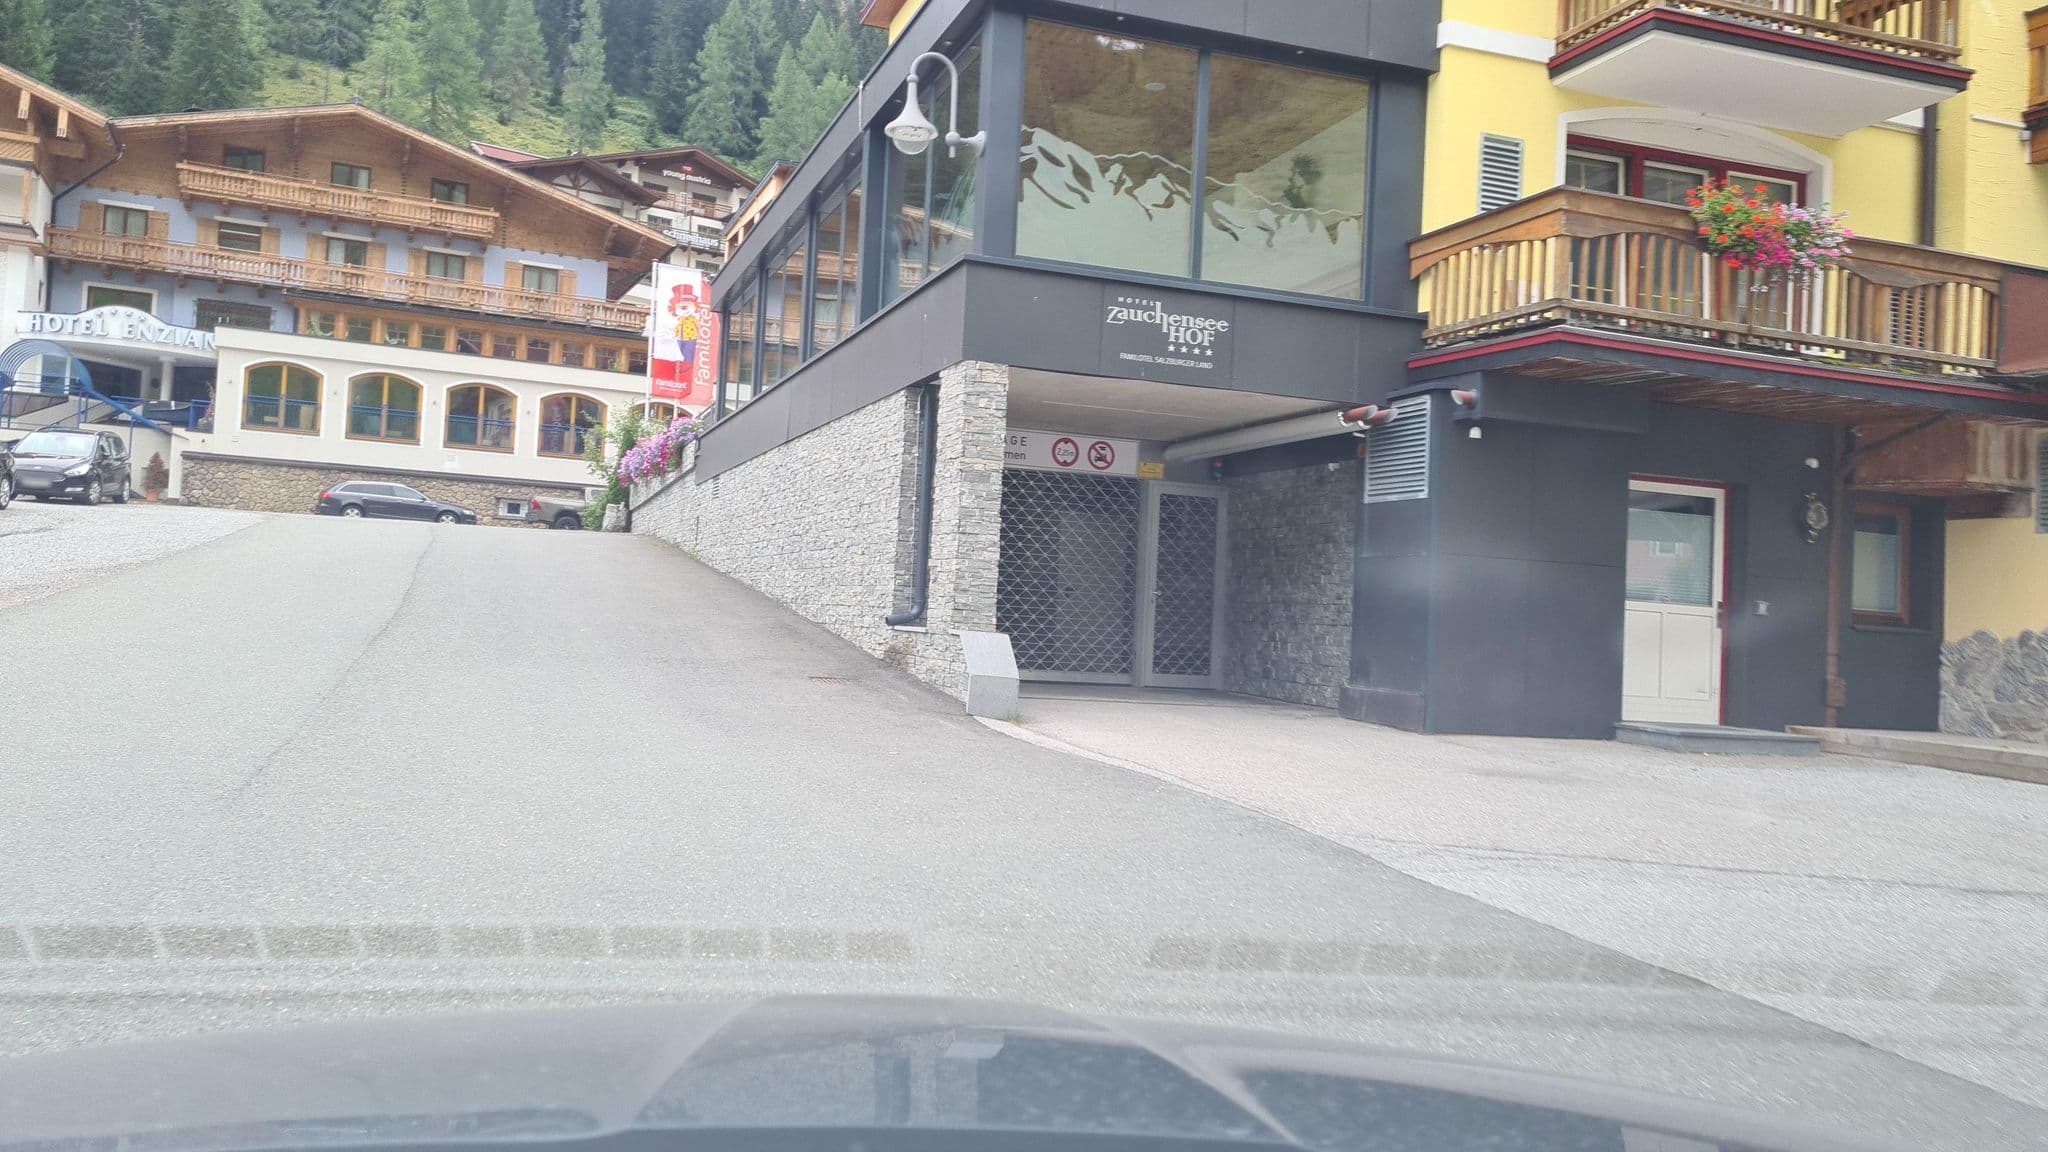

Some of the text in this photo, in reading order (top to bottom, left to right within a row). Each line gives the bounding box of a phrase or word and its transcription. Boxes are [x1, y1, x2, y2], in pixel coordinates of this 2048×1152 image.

[1106, 301, 1229, 333] Zauchensee
[1118, 297, 1154, 306] HOTEL
[29, 314, 216, 350] HOTEL ENZIAN
[695, 304, 711, 386] familotel
[1168, 326, 1215, 346] HOF
